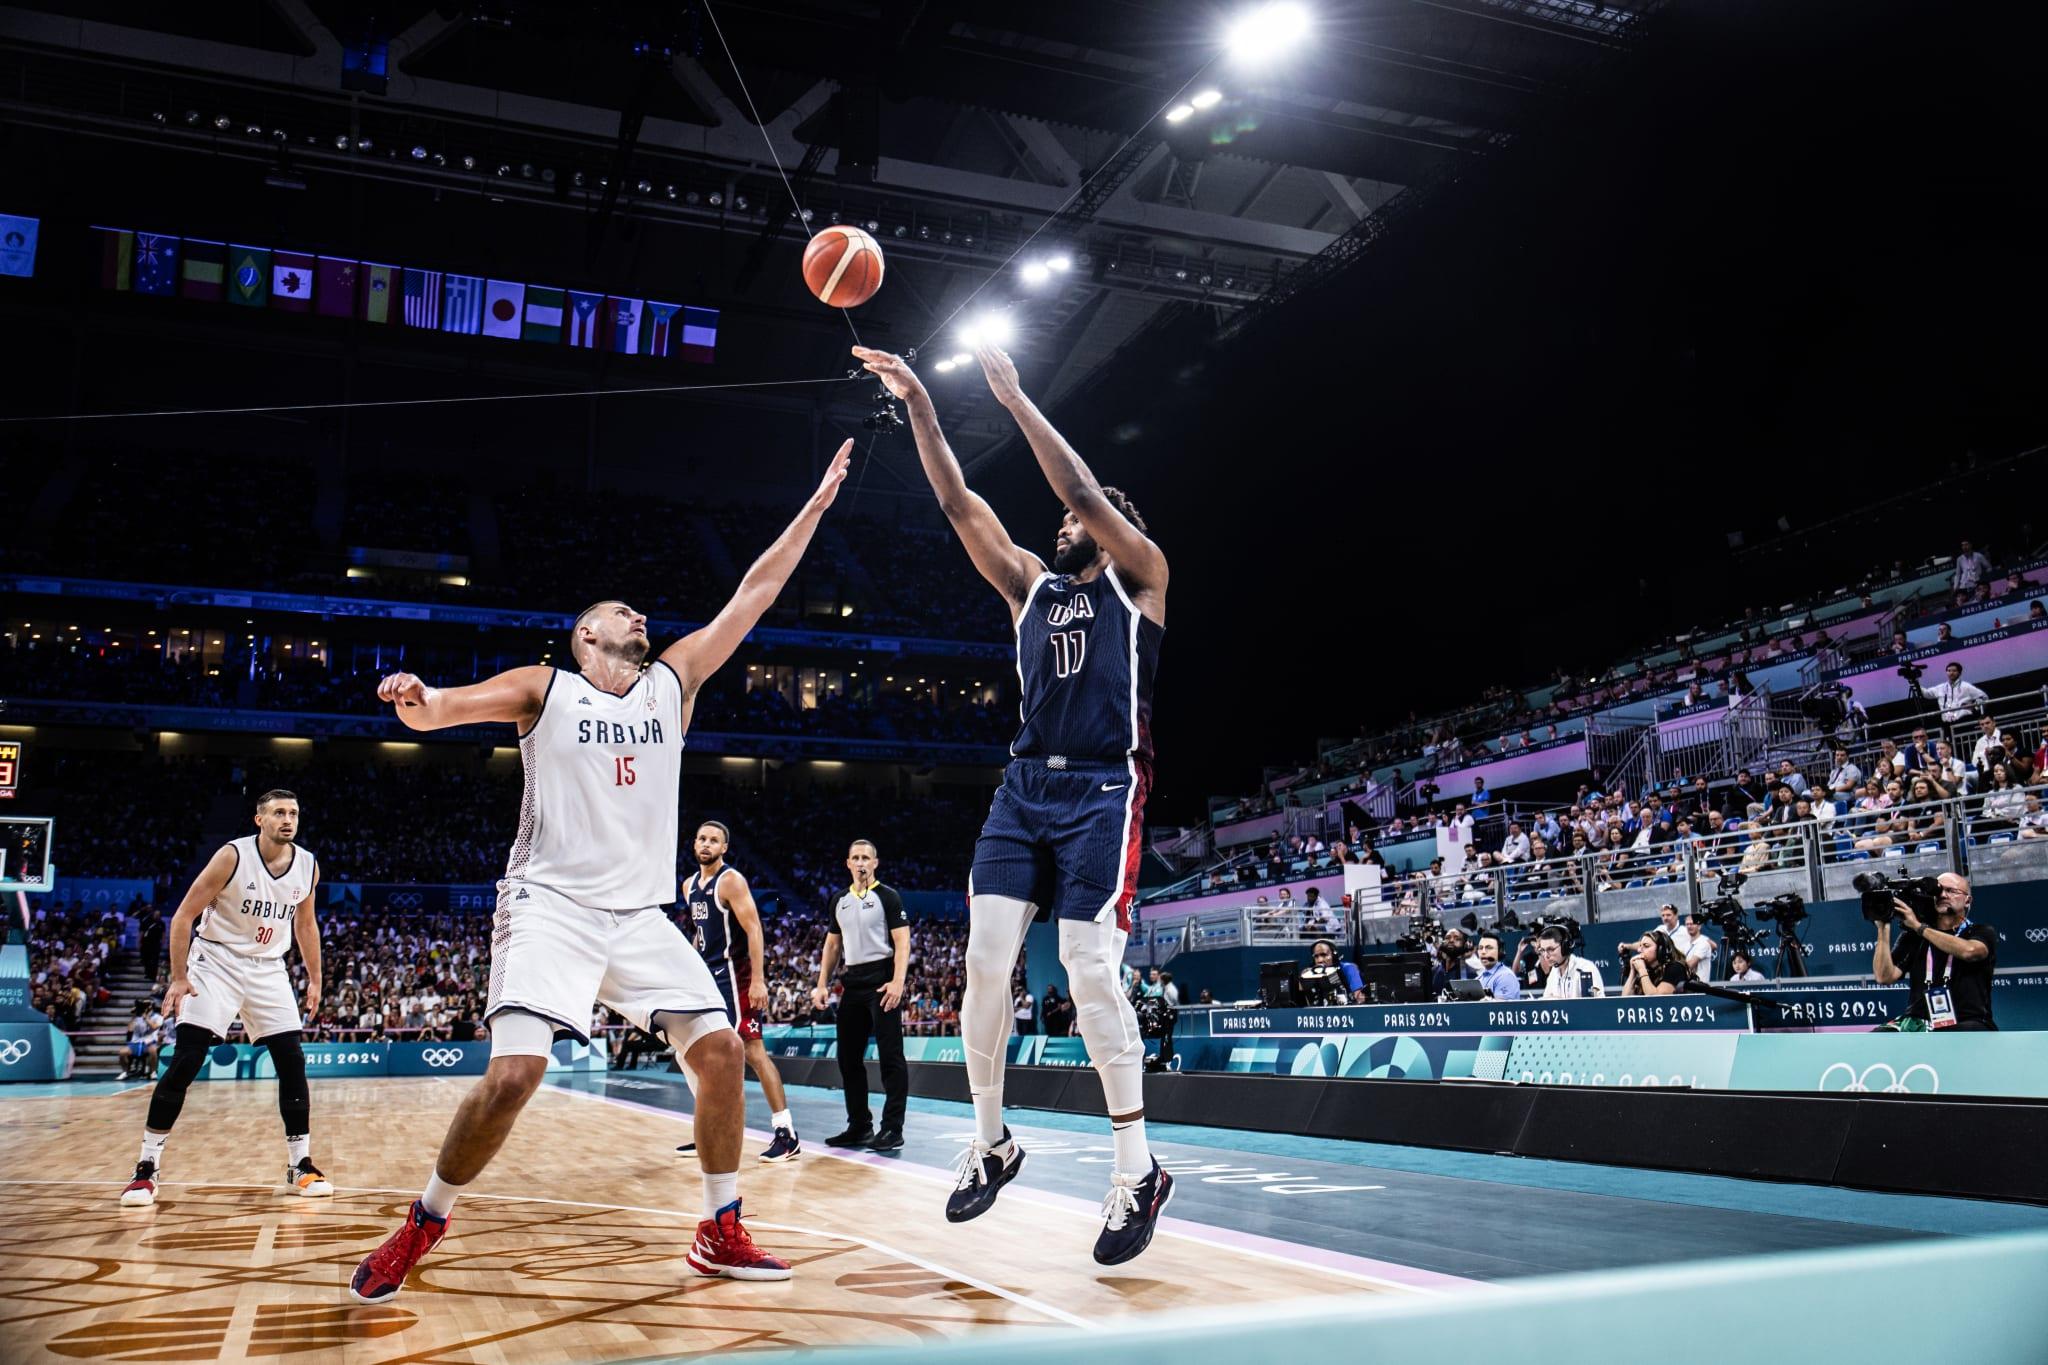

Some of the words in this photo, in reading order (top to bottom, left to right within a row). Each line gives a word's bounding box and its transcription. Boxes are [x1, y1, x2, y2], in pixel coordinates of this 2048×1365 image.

[1050, 630, 1085, 678] 11
[578, 718, 664, 744] SRBIJA
[615, 757, 637, 786] 15
[241, 899, 296, 921] SRBIJA
[459, 895, 495, 909] PAR
[255, 926, 274, 945] 30
[0, 988, 23, 997] ARIS
[0, 997, 23, 1006] 024
[1841, 1001, 1888, 1018] 2024
[1297, 1016, 1324, 1029] PARIS
[1326, 1015, 1354, 1028] 2024
[1384, 1014, 1416, 1027] PARIS
[1419, 1013, 1450, 1026] 2024
[1489, 1011, 1527, 1025] PARIS
[1531, 1009, 1569, 1025] 2024
[1617, 1007, 1664, 1024] PARIS
[1669, 1005, 1715, 1023] 2024
[1223, 1017, 1246, 1030] PARIS
[1248, 1016, 1271, 1029] 2024
[306, 1053, 332, 1065] RIS
[337, 1052, 380, 1065] 2024
